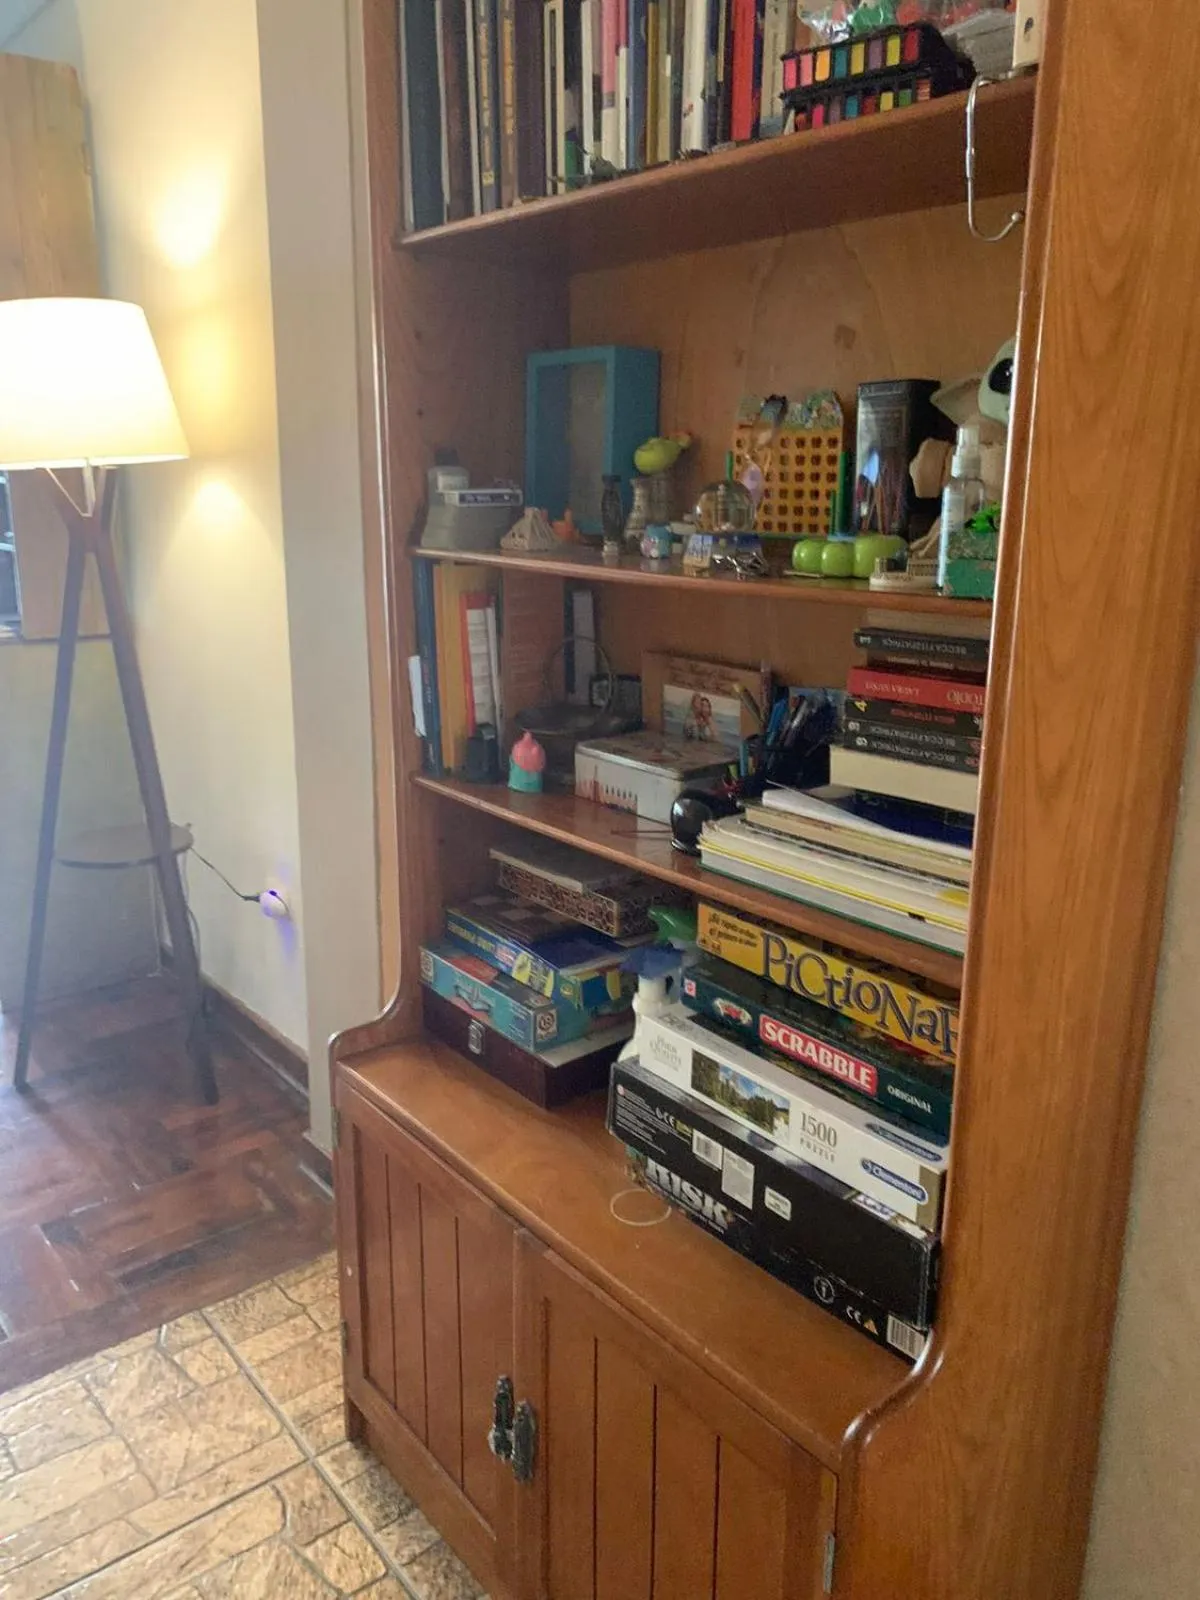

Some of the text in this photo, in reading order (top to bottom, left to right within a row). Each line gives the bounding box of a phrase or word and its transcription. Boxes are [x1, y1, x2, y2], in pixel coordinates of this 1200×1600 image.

[762, 1019, 873, 1090] SCRABBLE
[887, 1084, 932, 1114] ORIGINAL
[800, 1112, 837, 1148] 1500
